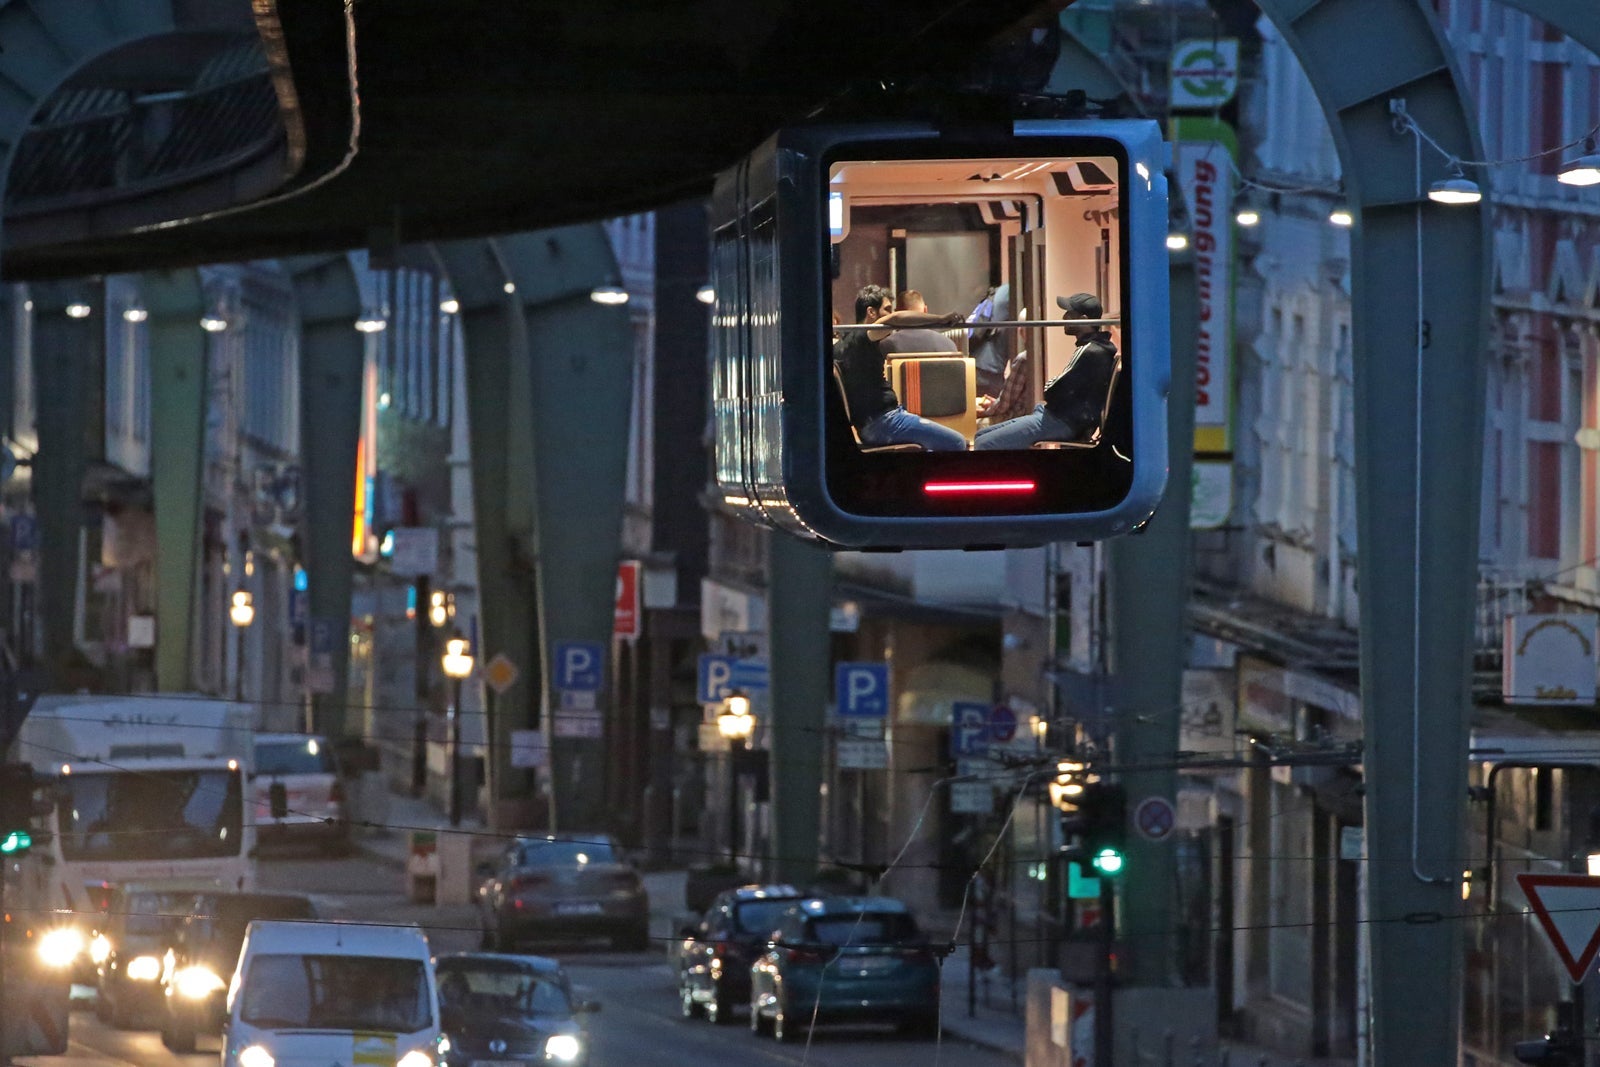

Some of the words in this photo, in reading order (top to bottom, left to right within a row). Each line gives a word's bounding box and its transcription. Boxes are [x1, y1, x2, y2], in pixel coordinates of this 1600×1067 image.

[566, 648, 591, 684] P
[708, 661, 730, 698] P
[848, 670, 877, 710] P
